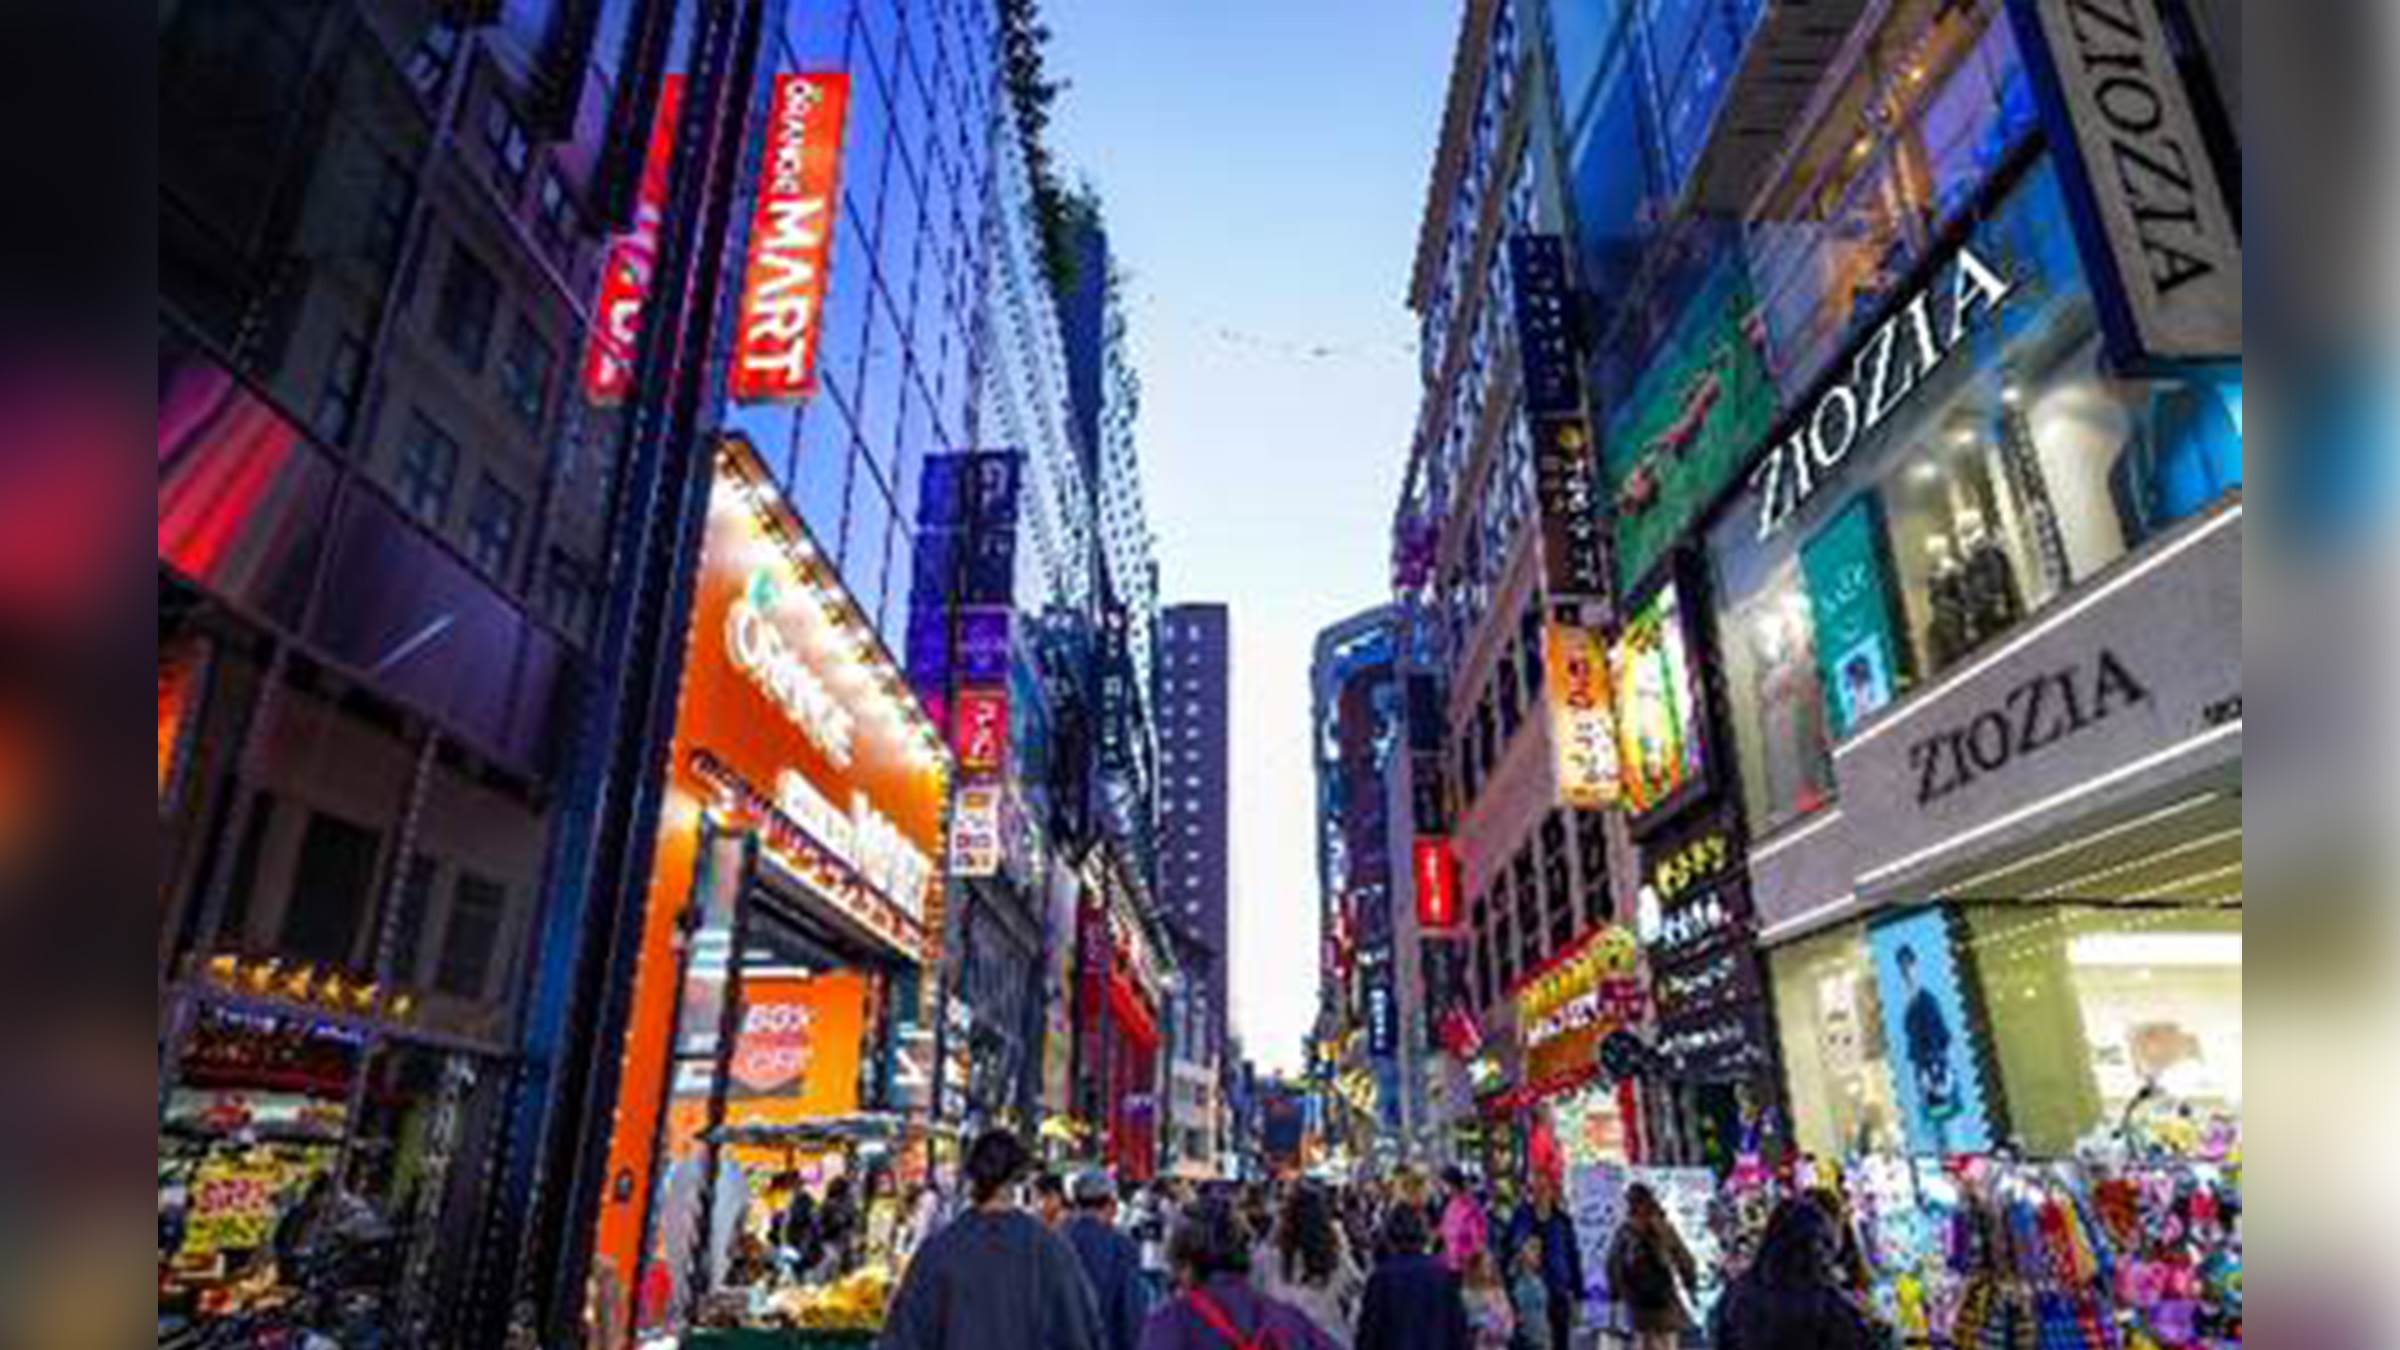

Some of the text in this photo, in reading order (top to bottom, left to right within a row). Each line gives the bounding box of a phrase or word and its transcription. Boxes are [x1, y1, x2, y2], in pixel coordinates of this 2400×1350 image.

[745, 78, 825, 384] ORANGE MART
[2068, 0, 2217, 295] ZIOZIA
[1747, 246, 2013, 541] ZIOZIA
[1909, 647, 2149, 806] ZIOZIA
